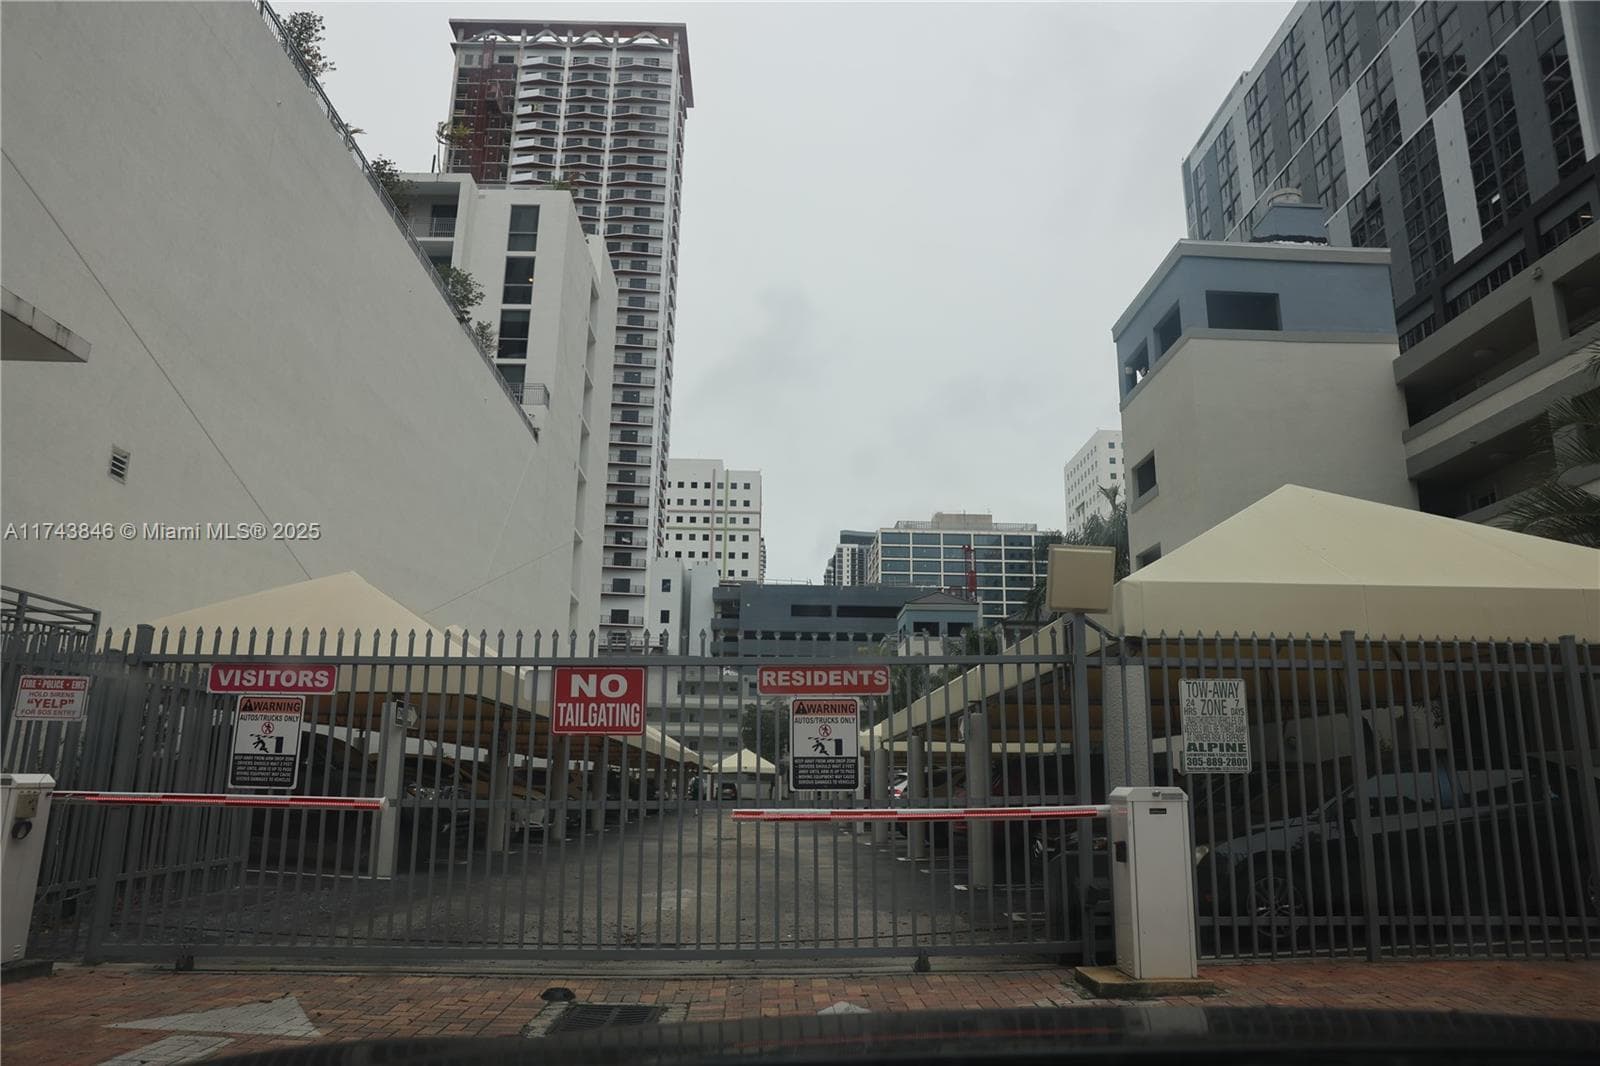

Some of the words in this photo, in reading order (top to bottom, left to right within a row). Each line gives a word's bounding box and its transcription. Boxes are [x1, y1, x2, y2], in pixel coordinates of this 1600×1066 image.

[42, 680, 65, 689] POLICE
[218, 669, 329, 688] VISITORS
[762, 670, 887, 687] RESIDENTS
[570, 674, 628, 698] NO
[1186, 681, 1240, 699] TOW-AWAY
[253, 701, 301, 713] WARNING
[806, 703, 856, 714] WARNING
[1200, 699, 1228, 716] ZONE
[1230, 707, 1245, 716] DAYS
[240, 714, 283, 722] AUTOS/TRUCKS
[284, 714, 300, 722] ONLY
[557, 702, 641, 727] TAILGATING
[795, 717, 839, 725] AUTOS/TRUCKS
[1186, 742, 1247, 753] ALPINE
